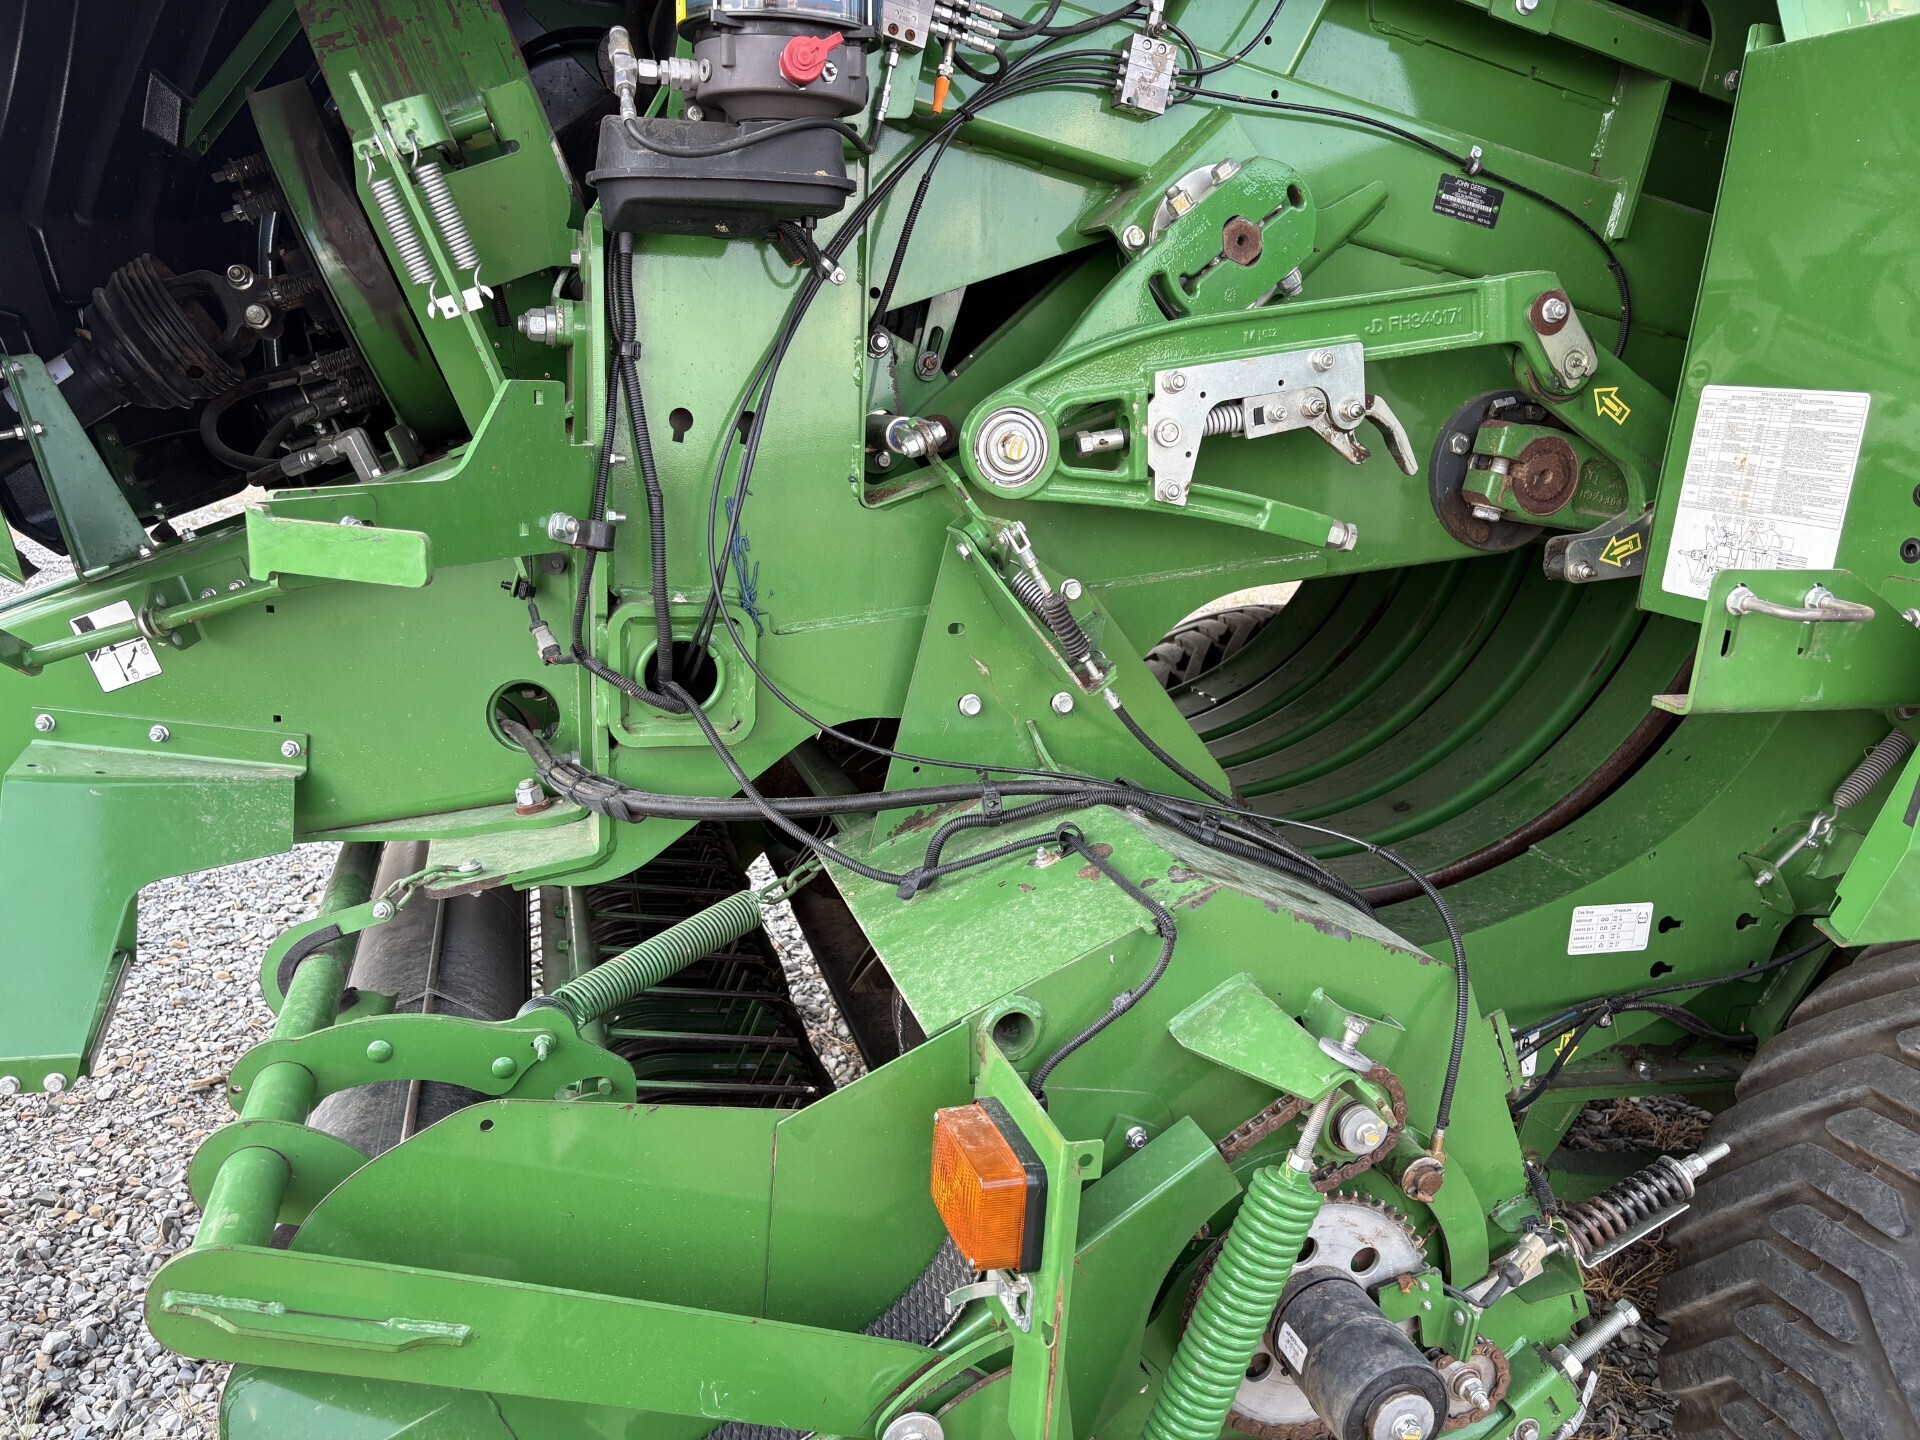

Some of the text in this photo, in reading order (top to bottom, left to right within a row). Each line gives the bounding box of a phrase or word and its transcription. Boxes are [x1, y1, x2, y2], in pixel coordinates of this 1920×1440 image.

[1455, 179, 1487, 193] JOHN DEERE
[1388, 306, 1463, 333] FH340171
